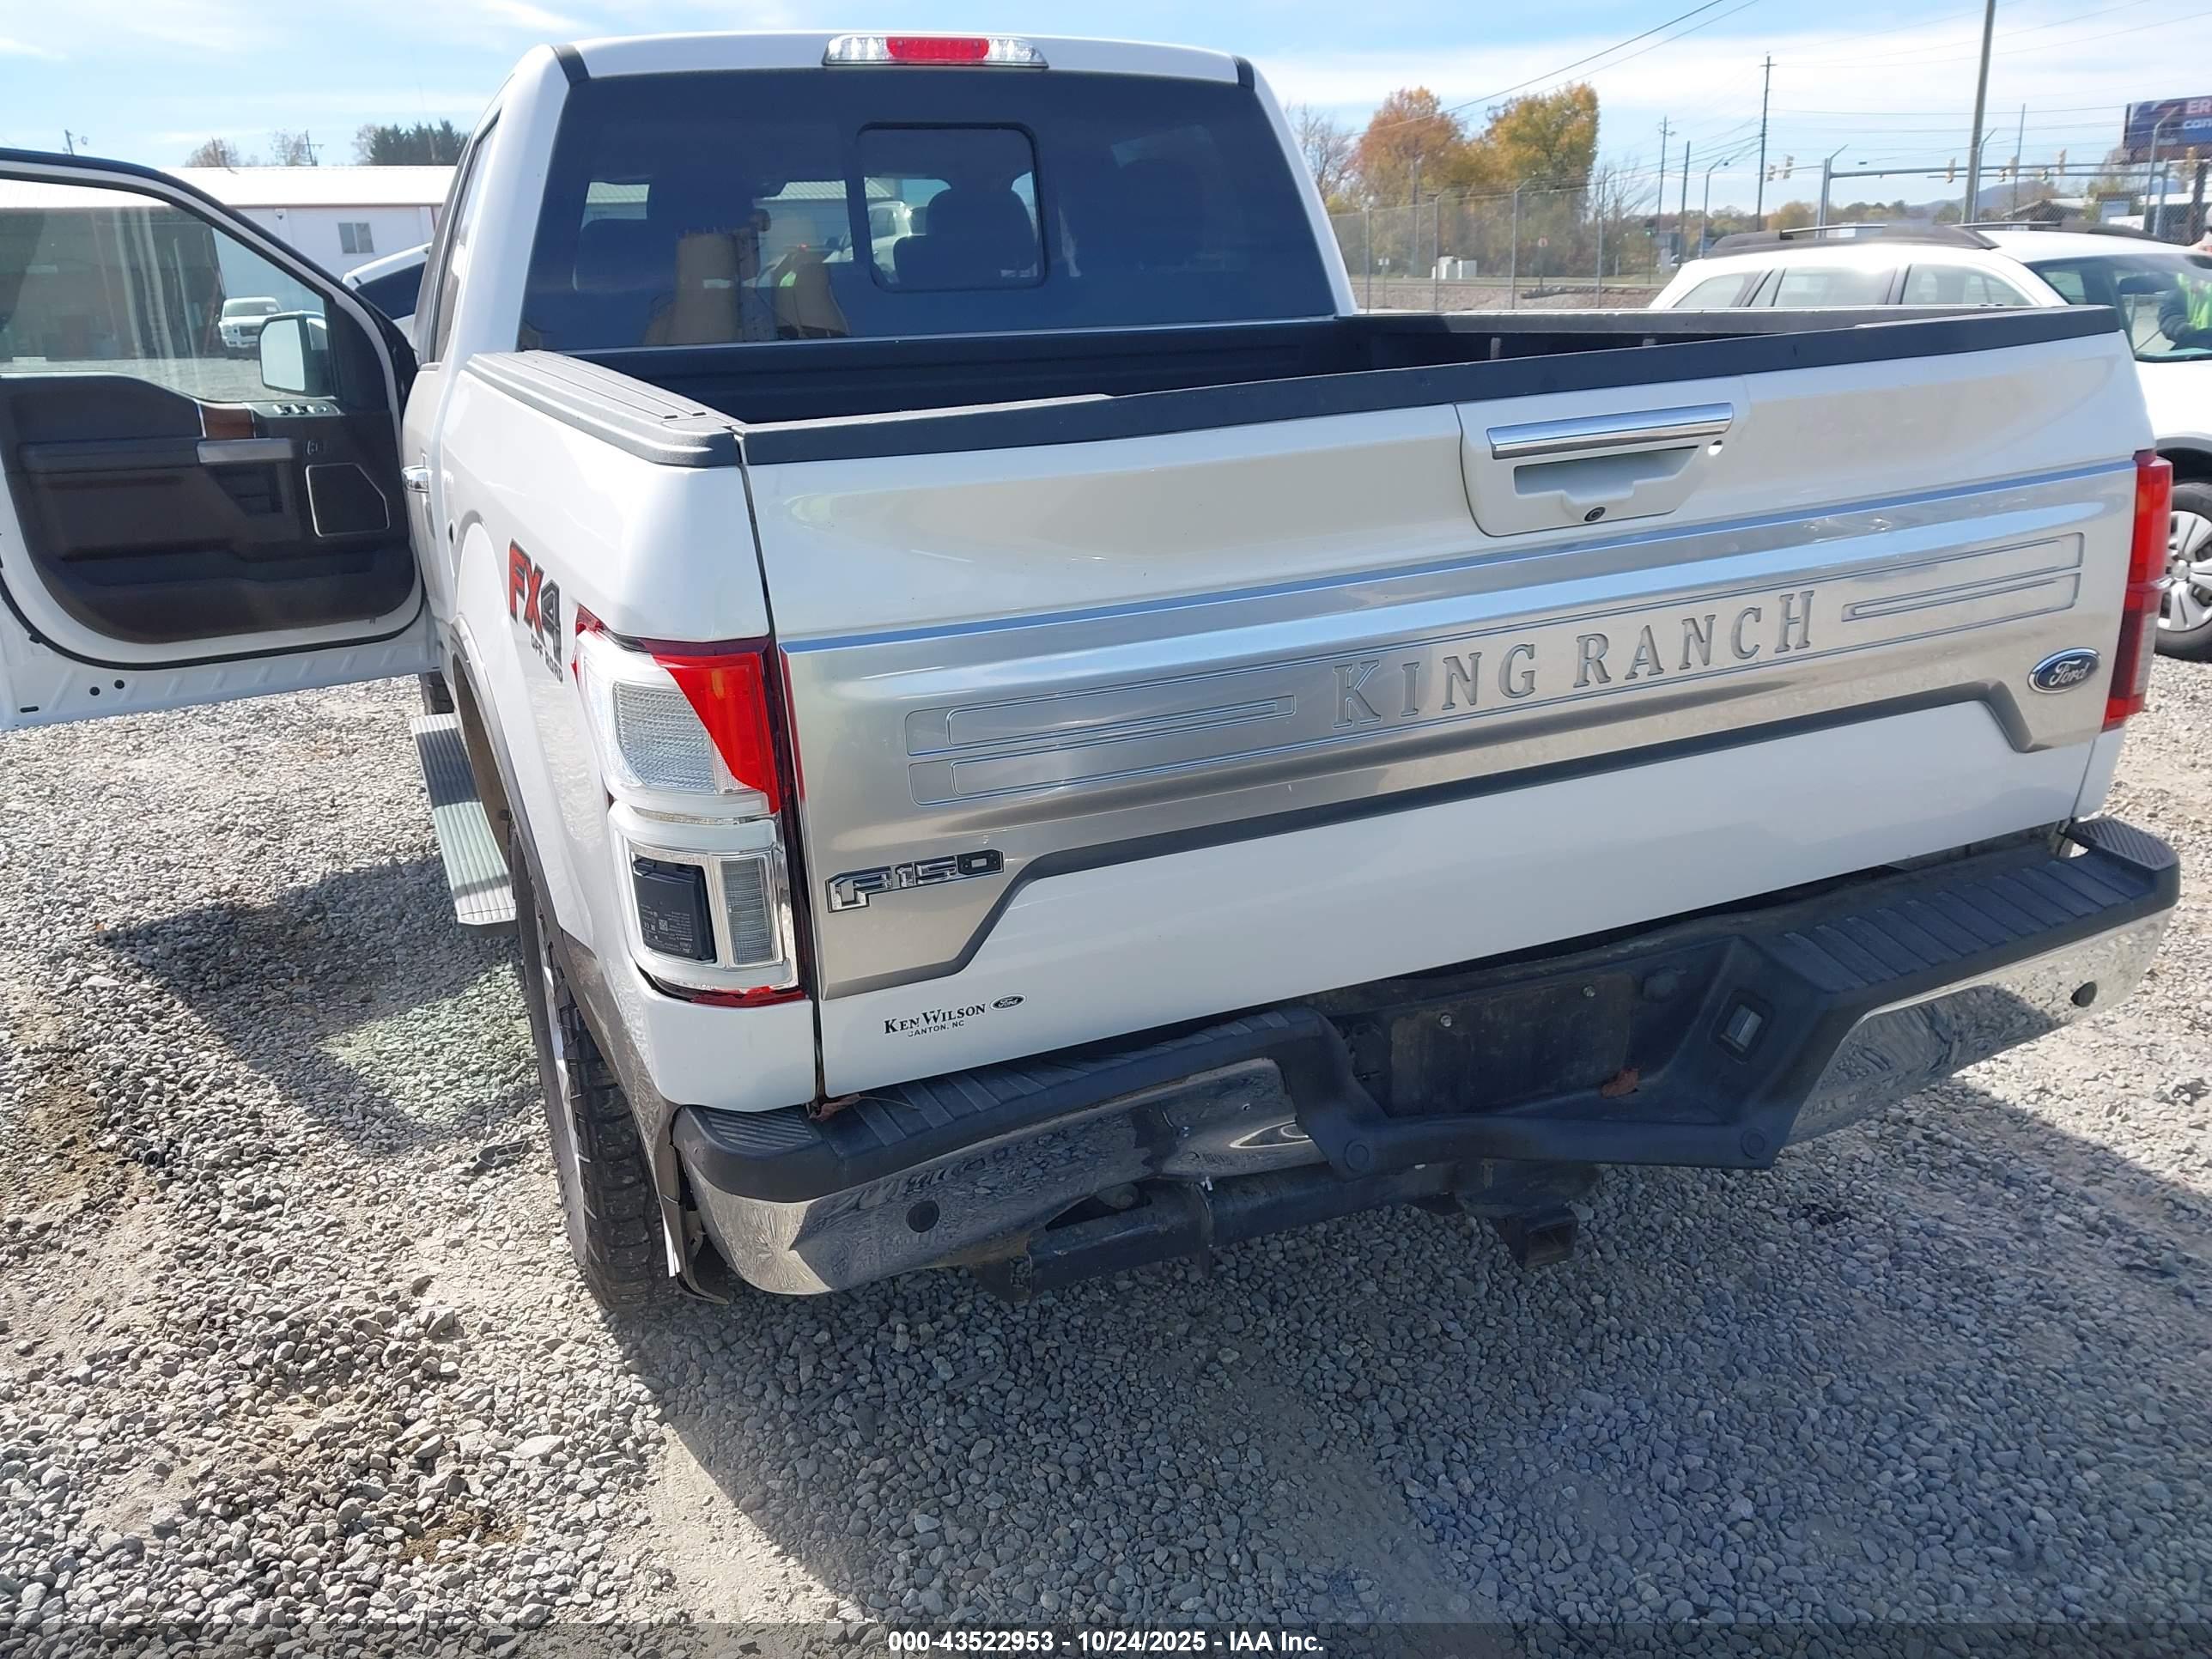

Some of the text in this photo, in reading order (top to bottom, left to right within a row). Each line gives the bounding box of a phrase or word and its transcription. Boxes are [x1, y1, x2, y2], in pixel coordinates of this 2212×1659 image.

[509, 538, 562, 668] FX4
[530, 631, 563, 684] OFF ROAD
[1333, 589, 1815, 729] KING RANCH
[951, 1019, 965, 1029] NC
